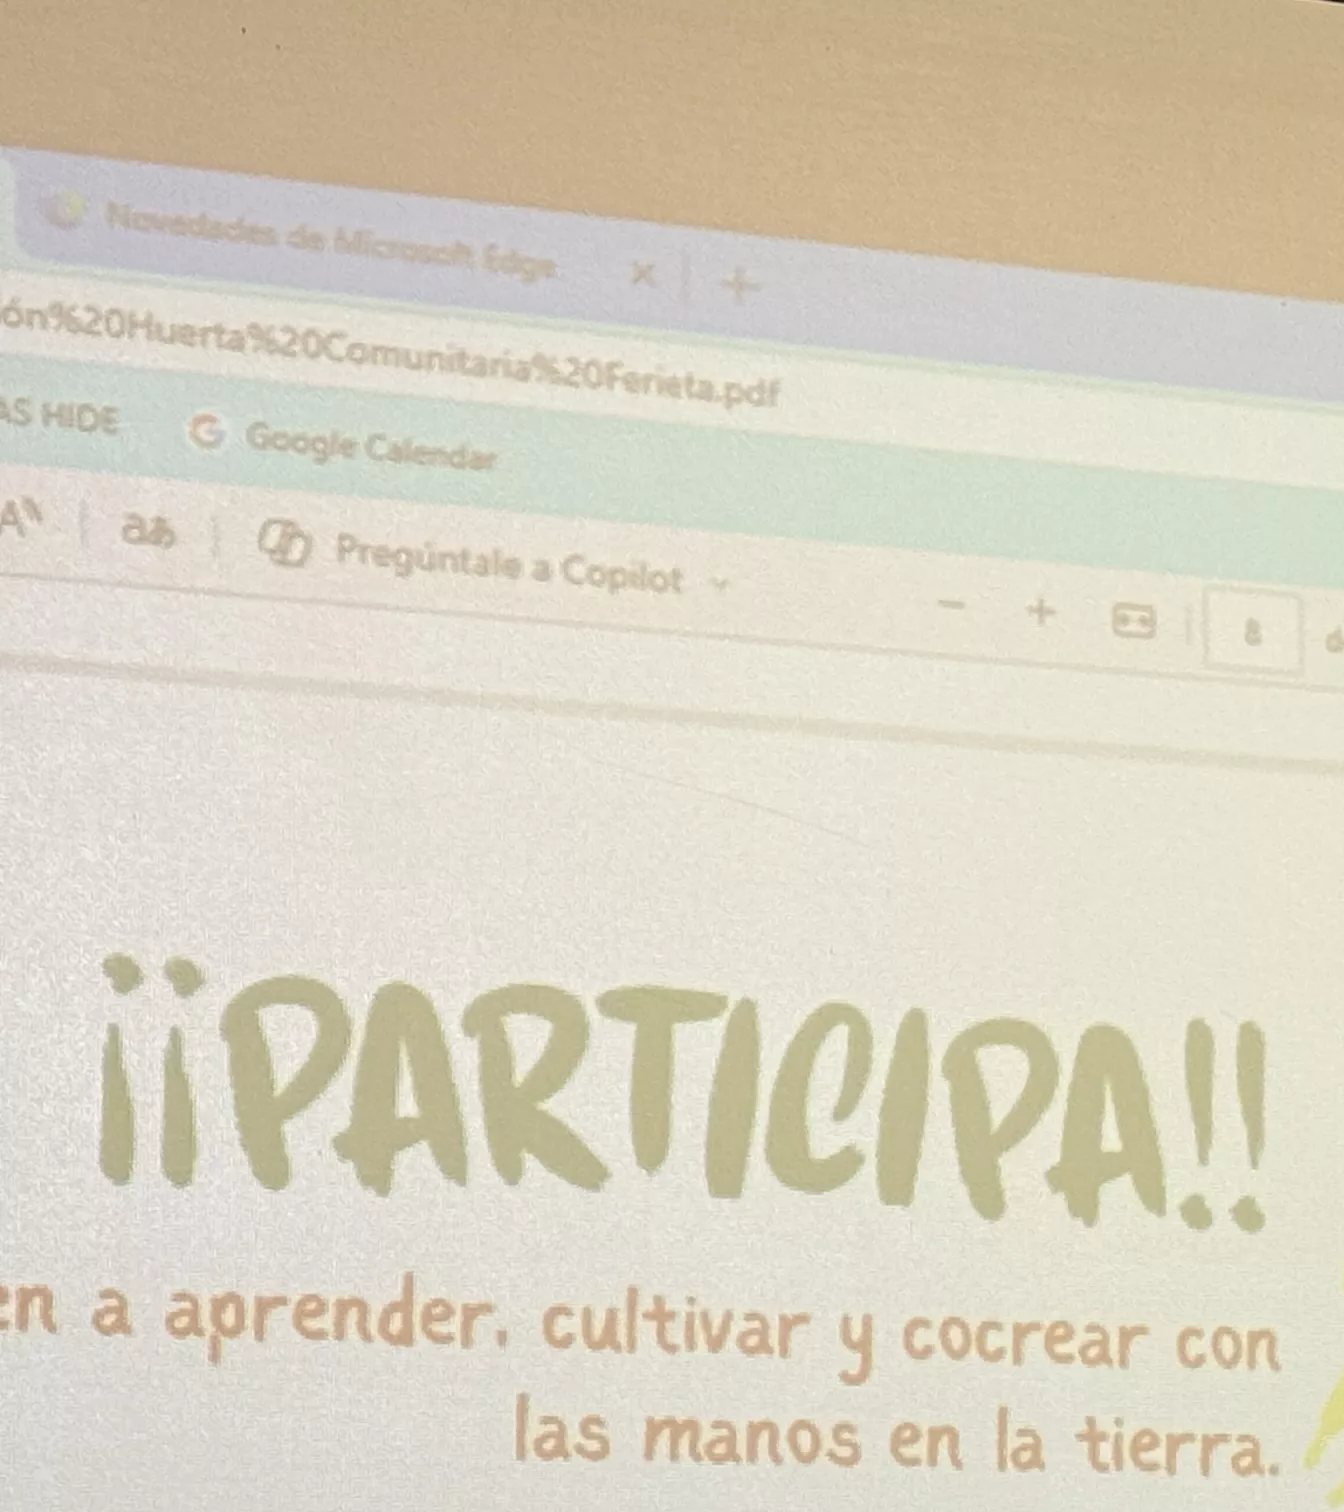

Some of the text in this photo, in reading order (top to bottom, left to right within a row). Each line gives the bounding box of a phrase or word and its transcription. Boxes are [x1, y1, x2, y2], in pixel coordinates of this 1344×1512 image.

[286, 223, 325, 253] de
[333, 226, 473, 266] Microsoft
[483, 242, 558, 285] Edge
[40, 402, 120, 435] HIDE
[245, 420, 357, 465] Google
[364, 432, 498, 471] Calendar
[337, 531, 684, 596] Pregúntale a Copilot
[99, 952, 1267, 1233] ¡¡PARTICIPA!!
[91, 1286, 134, 1337] a
[542, 1284, 811, 1359] cultivar
[839, 1312, 874, 1386] y
[902, 1315, 1150, 1369] cocrear
[1176, 1323, 1282, 1371] con
[515, 1392, 1281, 1478] las manos en la tierra.
